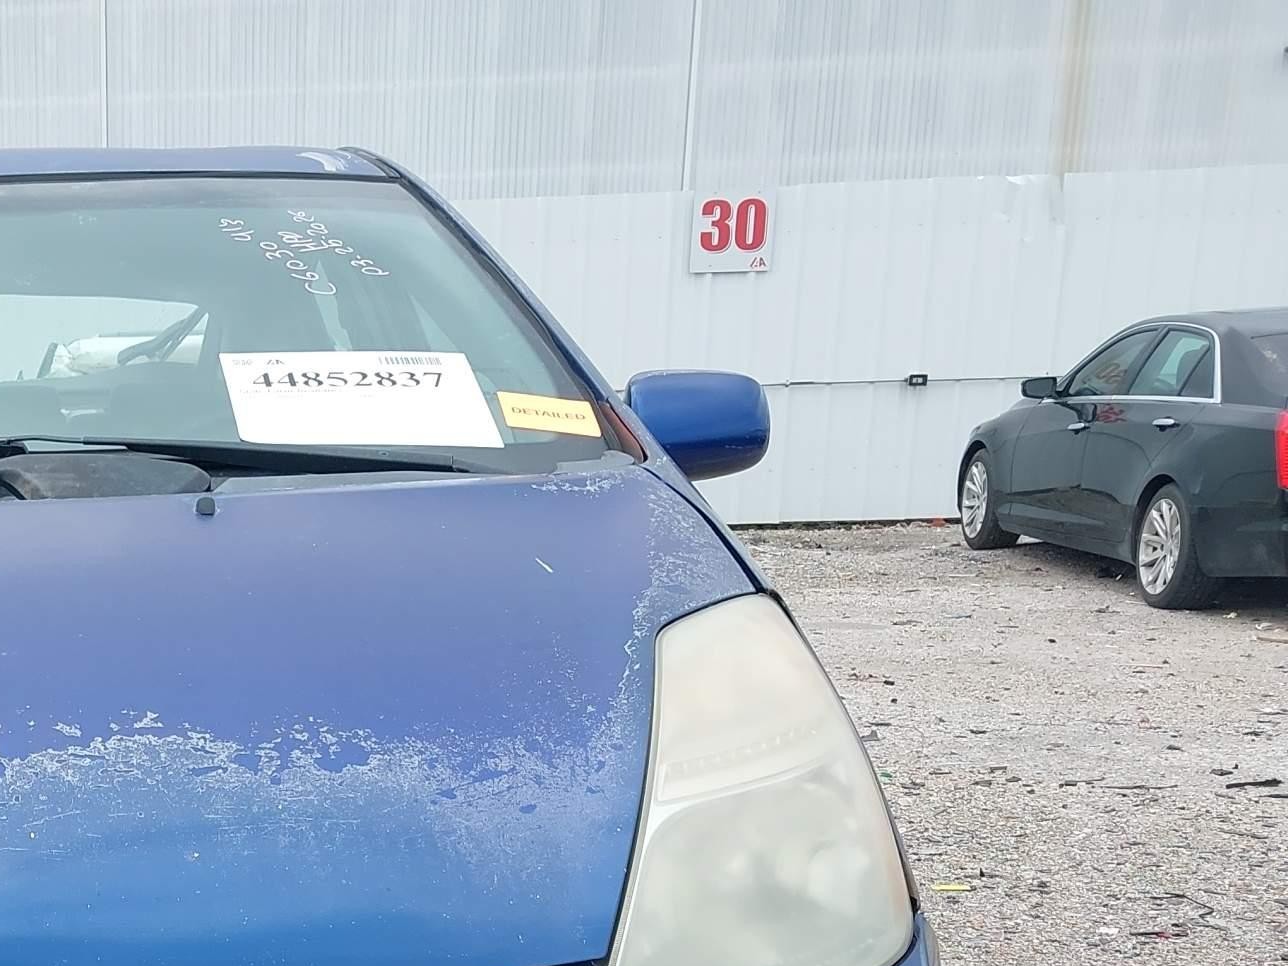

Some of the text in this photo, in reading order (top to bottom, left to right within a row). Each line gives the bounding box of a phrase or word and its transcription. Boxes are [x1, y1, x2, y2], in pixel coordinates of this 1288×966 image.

[699, 198, 768, 252] 30
[252, 371, 443, 388] 44852837
[511, 406, 587, 420] DETAILED
